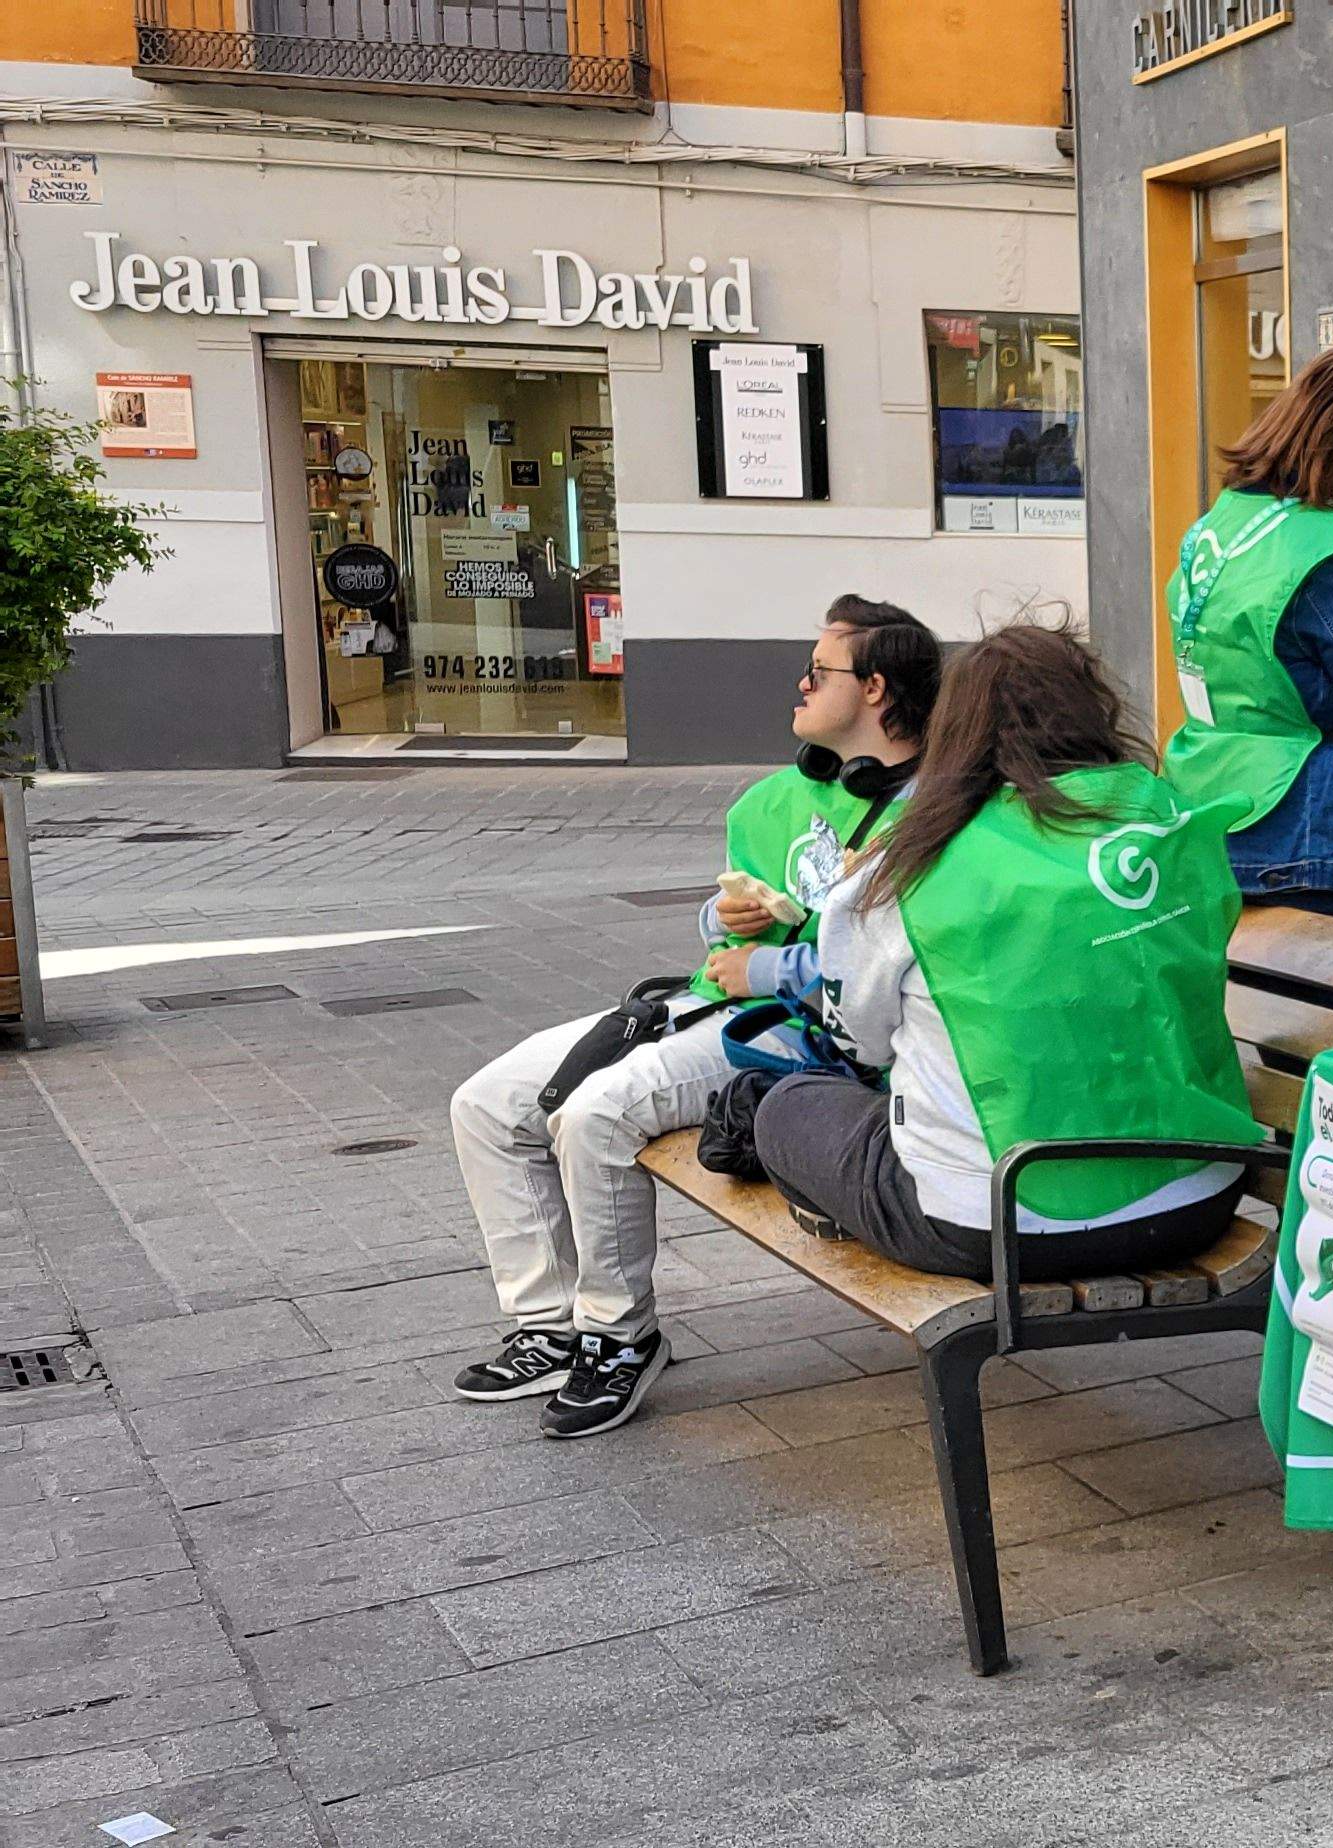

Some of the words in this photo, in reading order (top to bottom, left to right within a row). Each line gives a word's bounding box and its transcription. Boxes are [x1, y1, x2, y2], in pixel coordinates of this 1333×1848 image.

[33, 160, 81, 171] CALLE
[31, 177, 87, 190] SANCHO
[69, 231, 269, 317] Jean
[284, 240, 509, 325] Louis
[531, 249, 760, 334] David
[737, 407, 786, 418] REDKEN
[408, 430, 467, 456] Jean
[739, 451, 767, 469] ghd
[412, 491, 487, 518] David
[445, 571, 529, 582] CONSEGUIDO
[459, 562, 502, 572] HEMOS
[453, 581, 470, 591] LO
[472, 581, 534, 592] IMPOSIBLE
[423, 655, 465, 679] 974
[474, 655, 515, 679] 232
[1321, 1122, 1333, 1143] el
[511, 1350, 553, 1378] N
[605, 1367, 637, 1394] N
